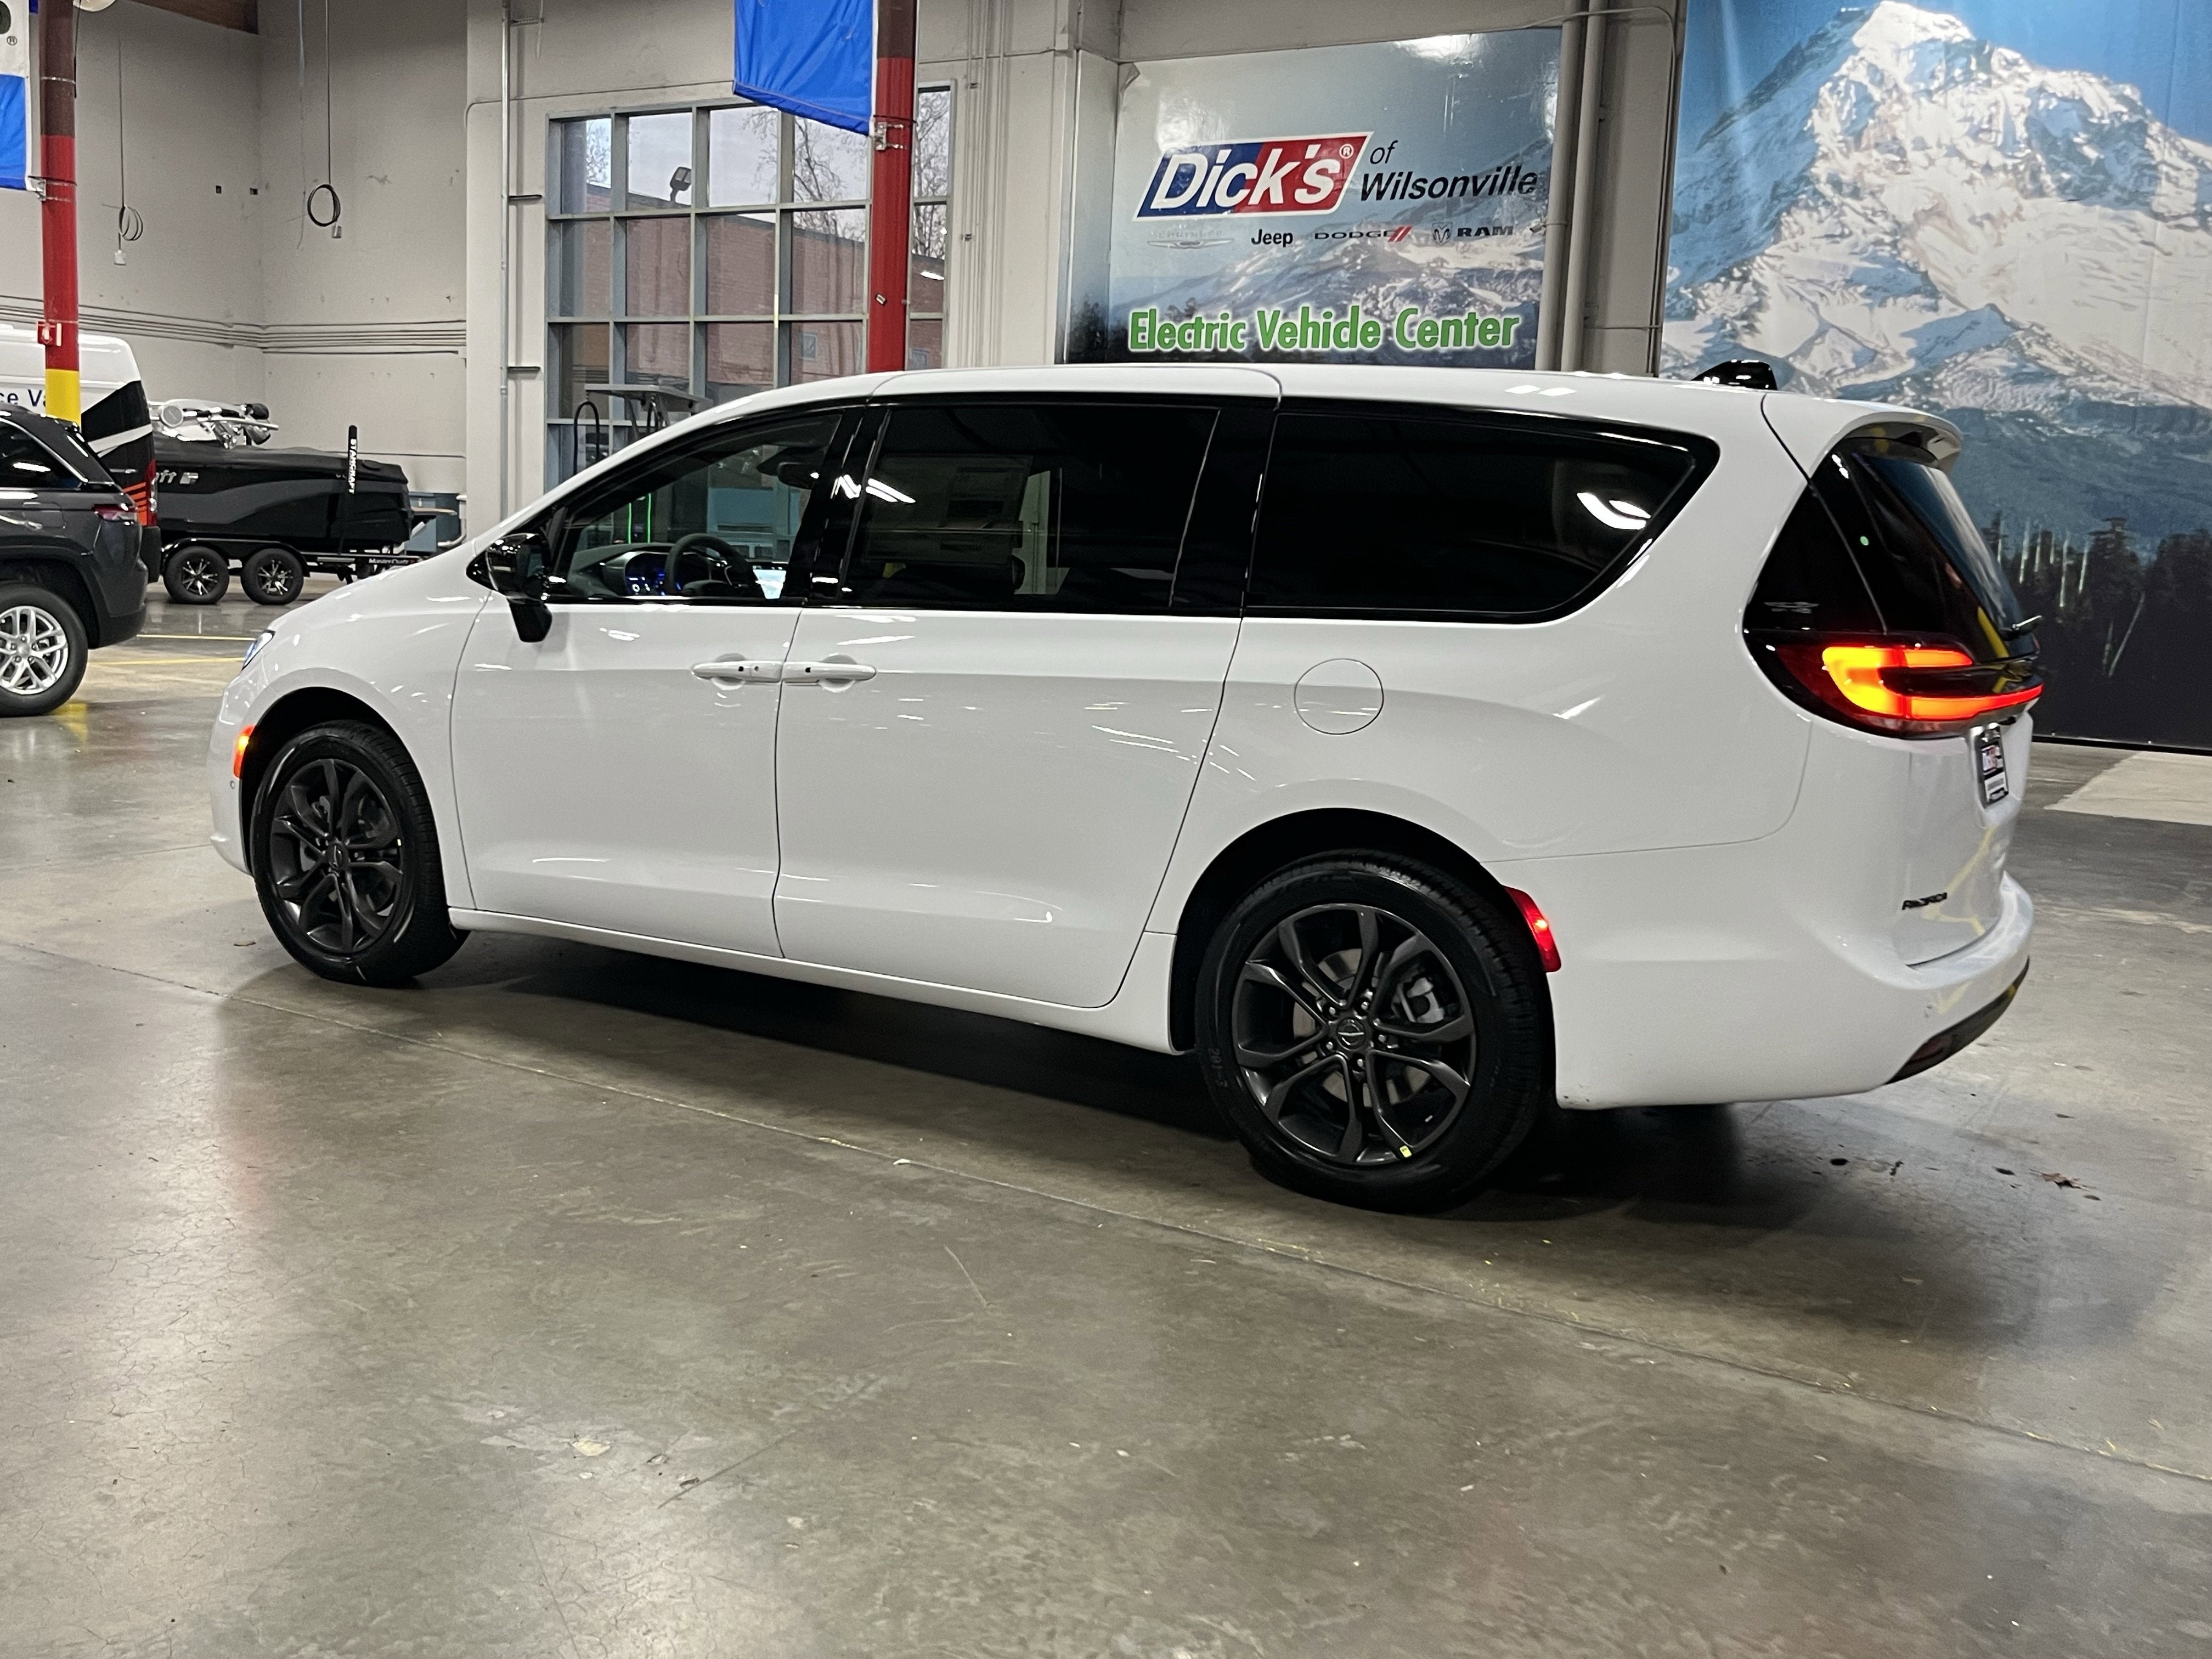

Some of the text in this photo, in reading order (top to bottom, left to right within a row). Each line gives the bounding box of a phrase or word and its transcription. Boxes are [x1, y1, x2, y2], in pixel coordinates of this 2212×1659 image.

[1369, 140, 1398, 165] of
[1361, 165, 1537, 201] Wilsonville
[1251, 229, 1294, 247] Jeep
[1457, 225, 1514, 237] RAM
[1130, 305, 1521, 349] Electric Vehicle Center
